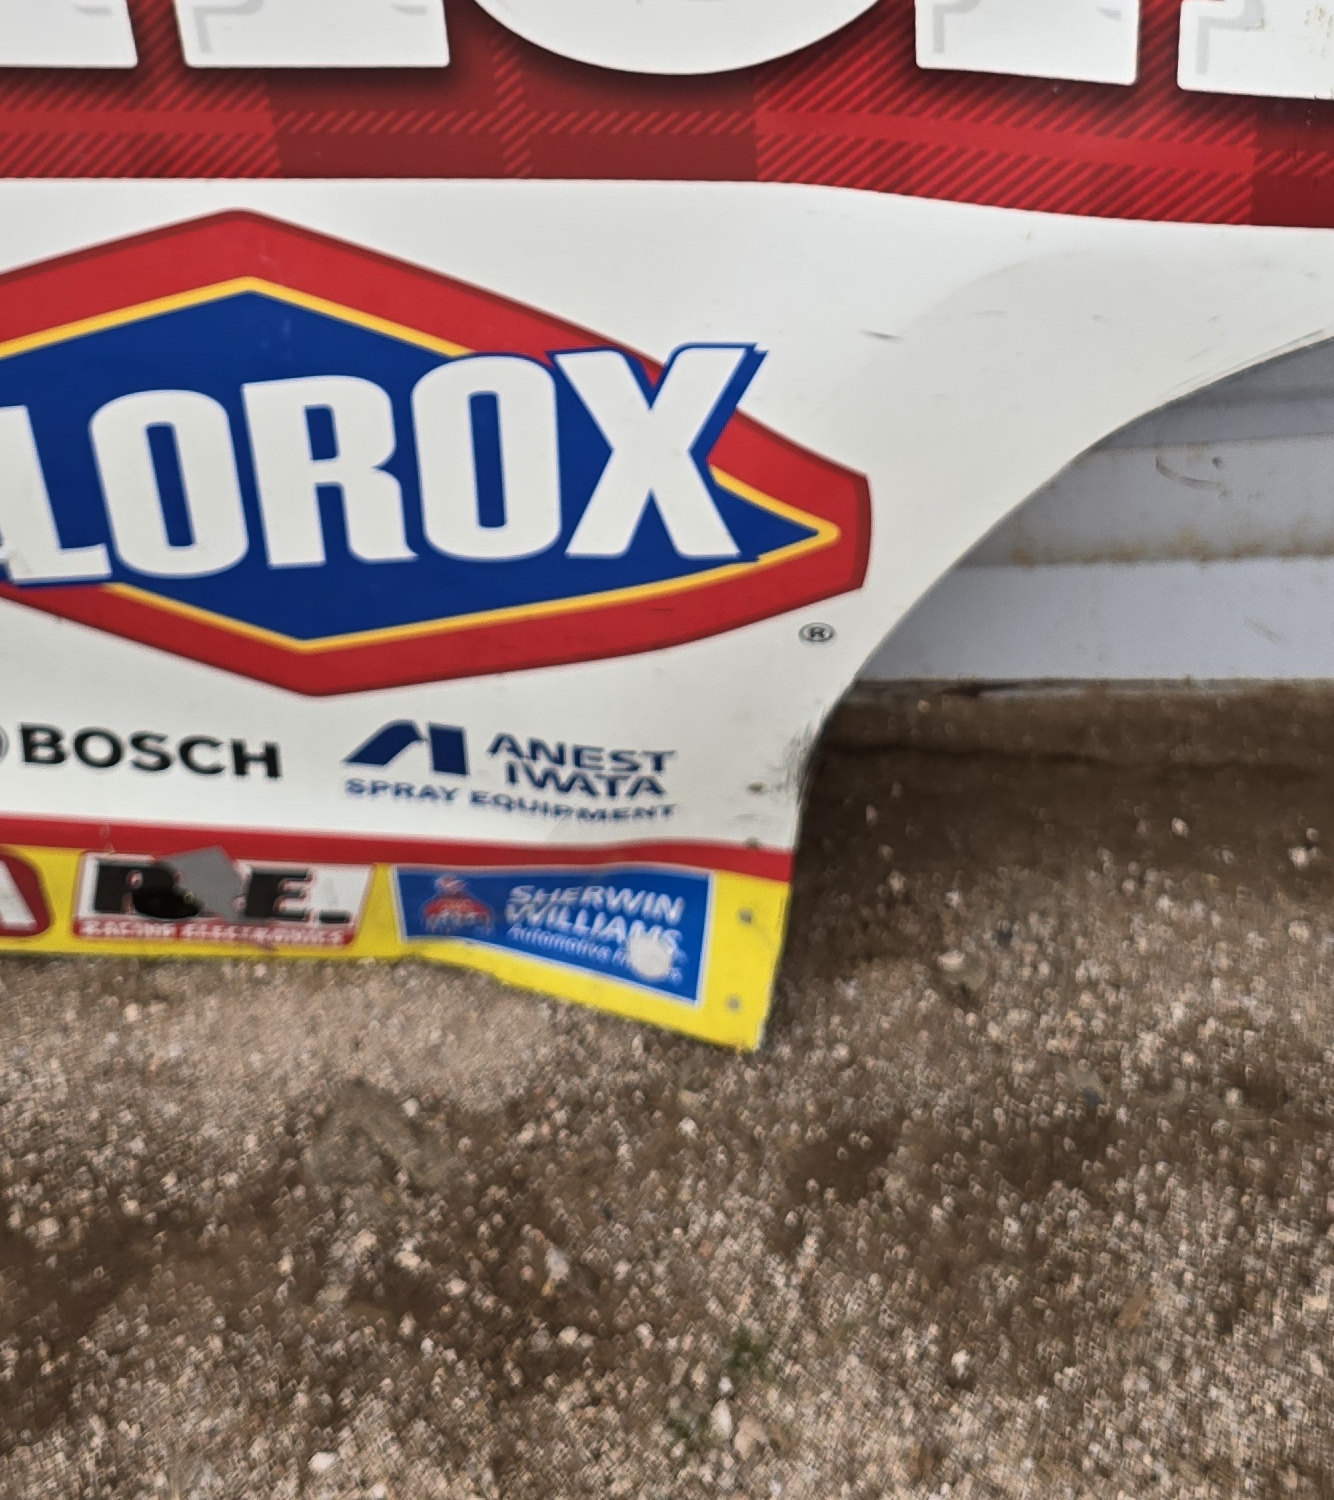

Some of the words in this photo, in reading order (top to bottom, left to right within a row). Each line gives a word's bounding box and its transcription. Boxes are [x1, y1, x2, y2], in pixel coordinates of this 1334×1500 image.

[18, 721, 283, 781] BOSCH
[486, 731, 677, 773] ANEST
[344, 777, 460, 803] SPRAY
[468, 789, 677, 823] EQUIPMENT
[505, 759, 668, 799] IWATA
[508, 884, 686, 925] SHERWIN
